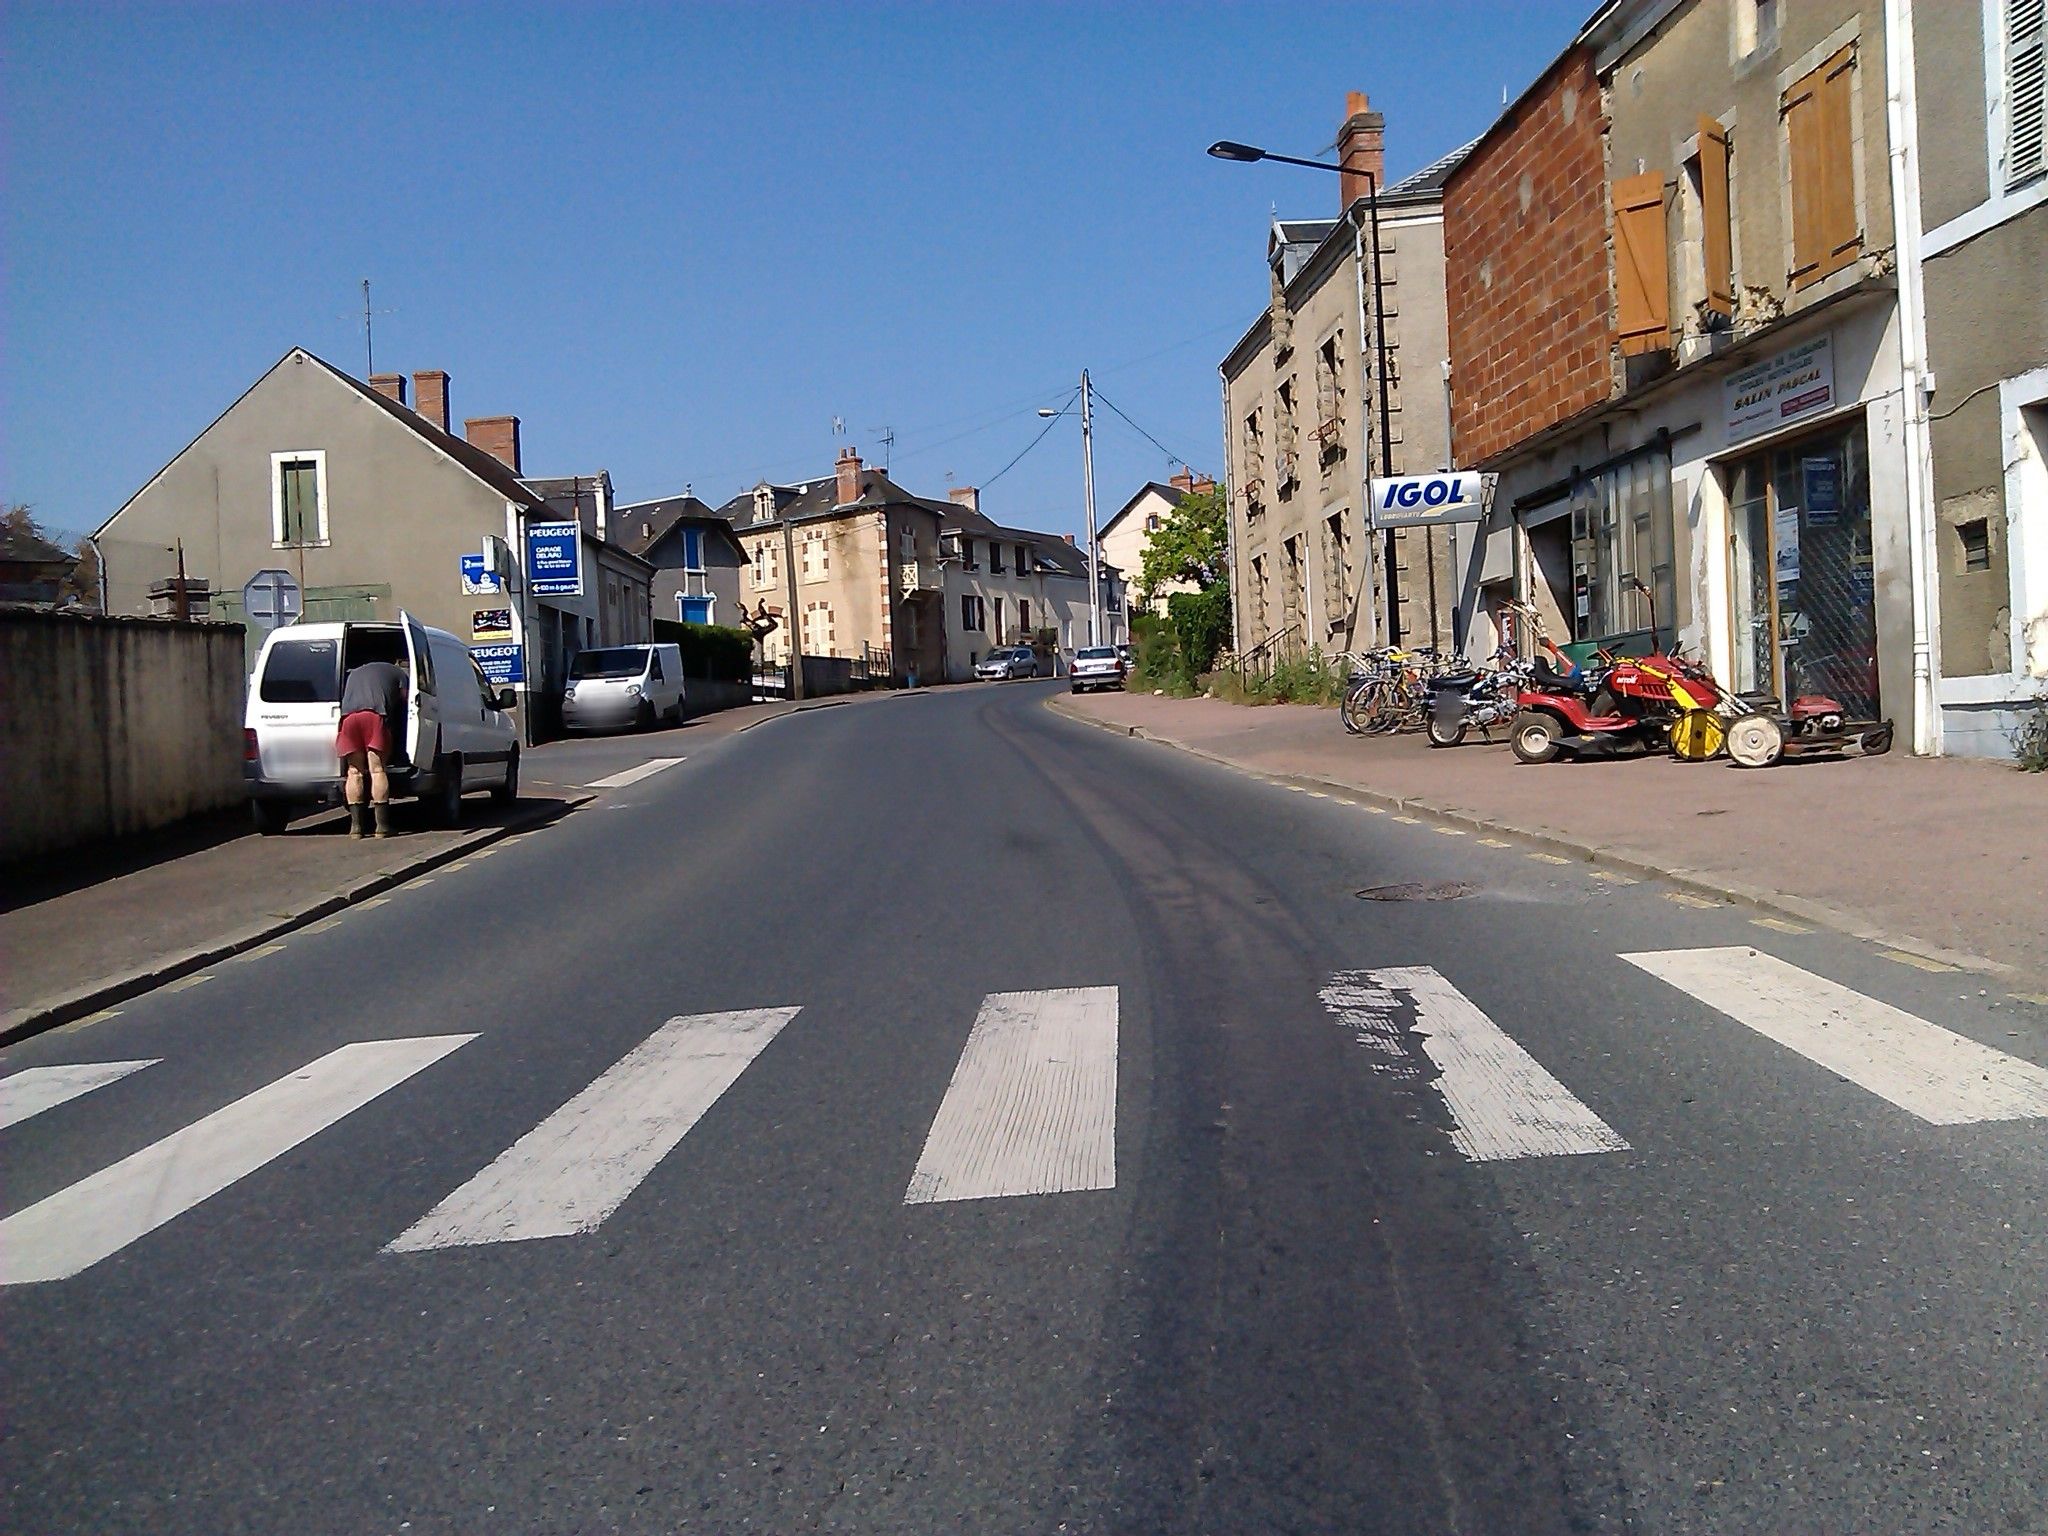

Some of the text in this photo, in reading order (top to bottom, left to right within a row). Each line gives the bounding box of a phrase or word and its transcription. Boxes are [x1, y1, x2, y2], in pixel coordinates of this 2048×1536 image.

[1777, 368, 1821, 395] PASCAL
[1383, 479, 1464, 509] IGOL
[529, 528, 576, 538] PEUGEOT
